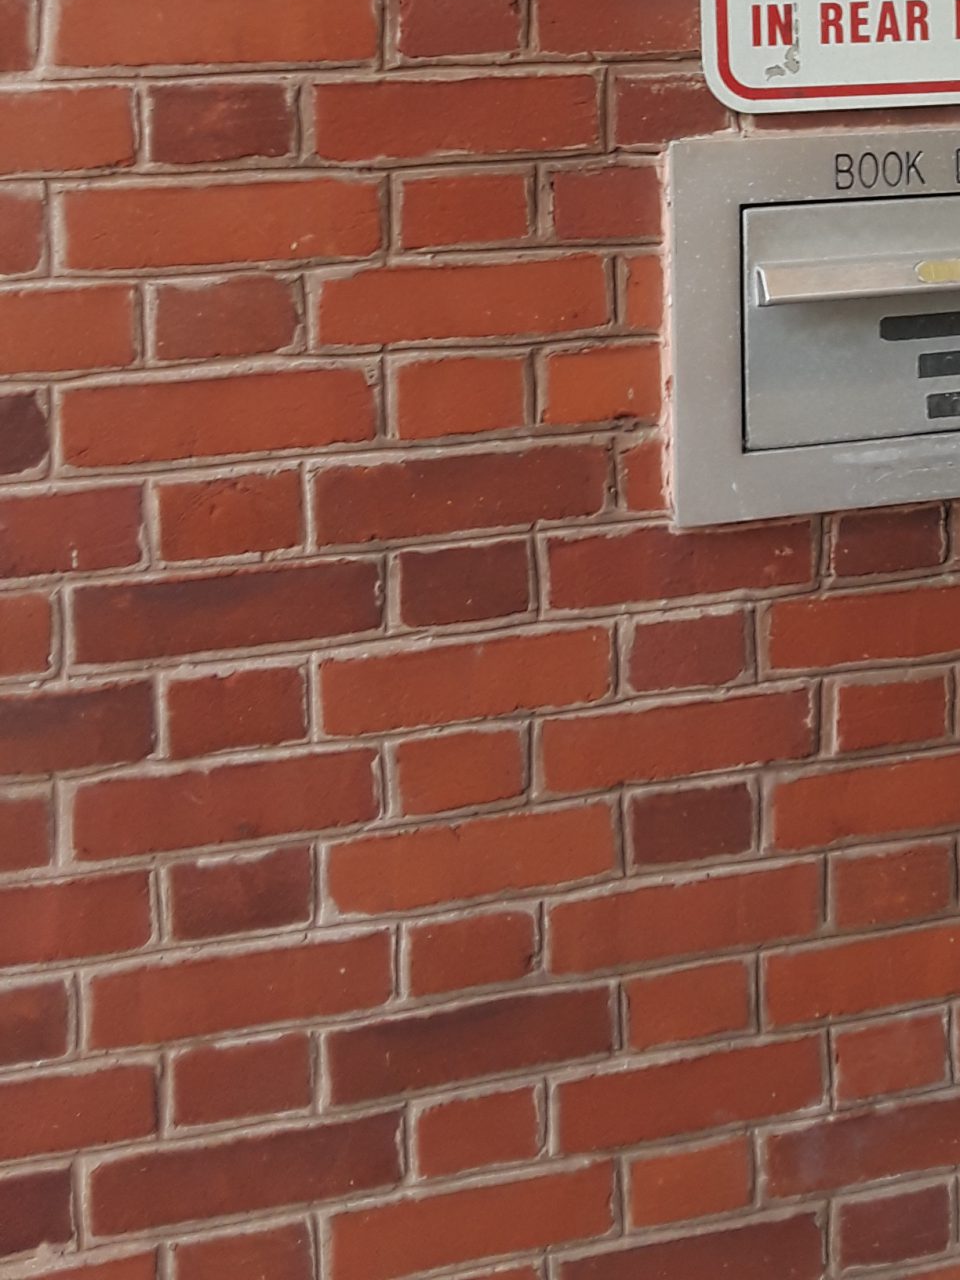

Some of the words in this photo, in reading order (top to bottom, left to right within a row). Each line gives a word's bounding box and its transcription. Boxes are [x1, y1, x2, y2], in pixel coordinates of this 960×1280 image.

[751, 4, 793, 47] IN
[820, 0, 930, 45] REAR
[834, 150, 925, 190] BOOK
